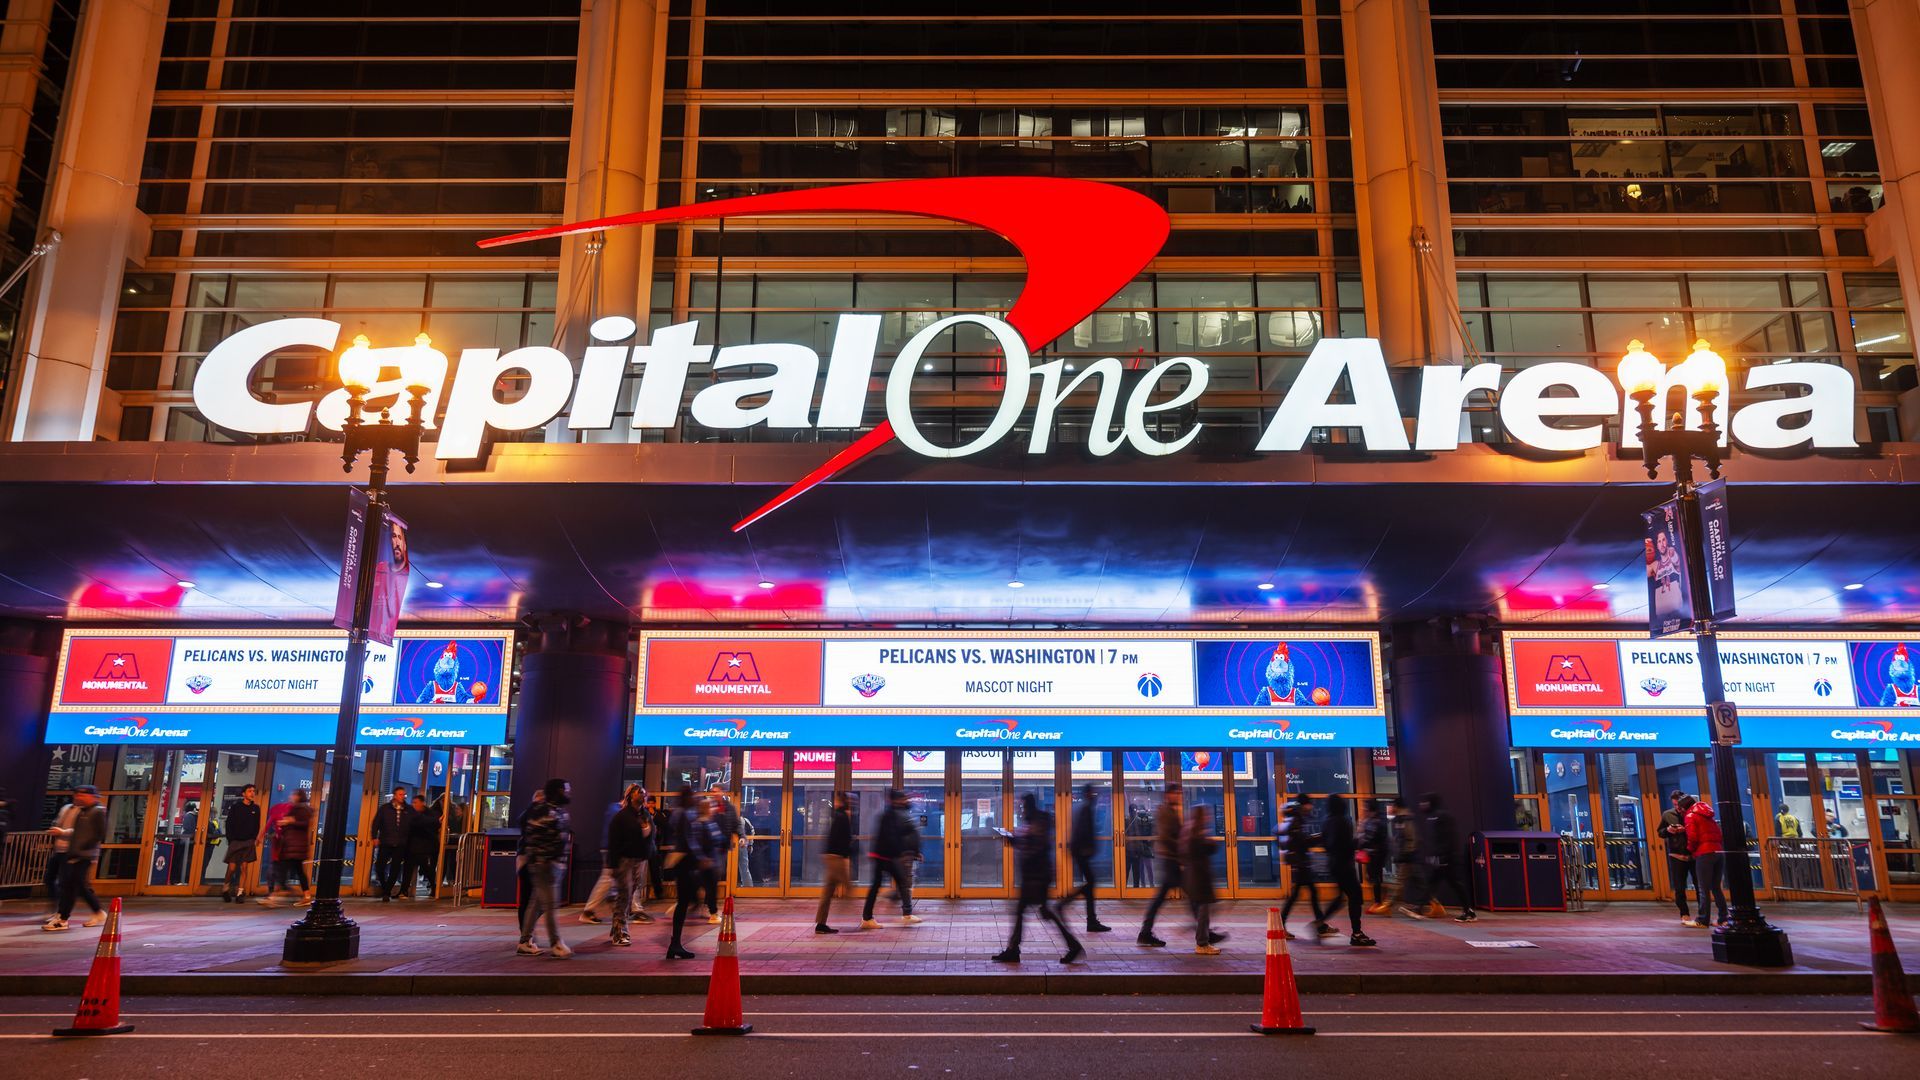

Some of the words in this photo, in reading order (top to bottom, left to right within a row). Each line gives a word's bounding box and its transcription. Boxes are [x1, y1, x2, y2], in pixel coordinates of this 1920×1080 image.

[1254, 337, 1860, 452] Arena
[1713, 519, 1723, 563] CAPITAL
[184, 650, 244, 662] PELICANS
[248, 650, 267, 662] VS.
[271, 650, 347, 662] WASHINGTO
[373, 654, 386, 662] PM
[879, 649, 957, 664] PELICANS
[961, 649, 986, 664] VS.
[990, 649, 1095, 664] WASHINGTON
[1107, 649, 1118, 664] 7
[1122, 654, 1138, 664] PM
[1631, 652, 1694, 664] PELICANS
[1719, 652, 1804, 665] WASHINGTON
[1812, 653, 1820, 665] 7
[1825, 656, 1838, 665] PM
[81, 681, 148, 690] MONUMENTAL
[244, 679, 286, 690] MASCOT
[287, 679, 319, 690] NIGHT
[695, 684, 771, 694] MONUMENTAL
[965, 681, 1013, 693] MASCOT
[1017, 681, 1053, 693] NIGHT
[1535, 683, 1604, 692] MONUMENTAL
[1745, 682, 1775, 693] NIGHT
[150, 728, 189, 738] Arena
[427, 728, 465, 738] Arena
[751, 730, 789, 739] Arena
[1023, 731, 1062, 740] Arena
[1296, 731, 1335, 740] Arena
[1618, 731, 1657, 740] Arena
